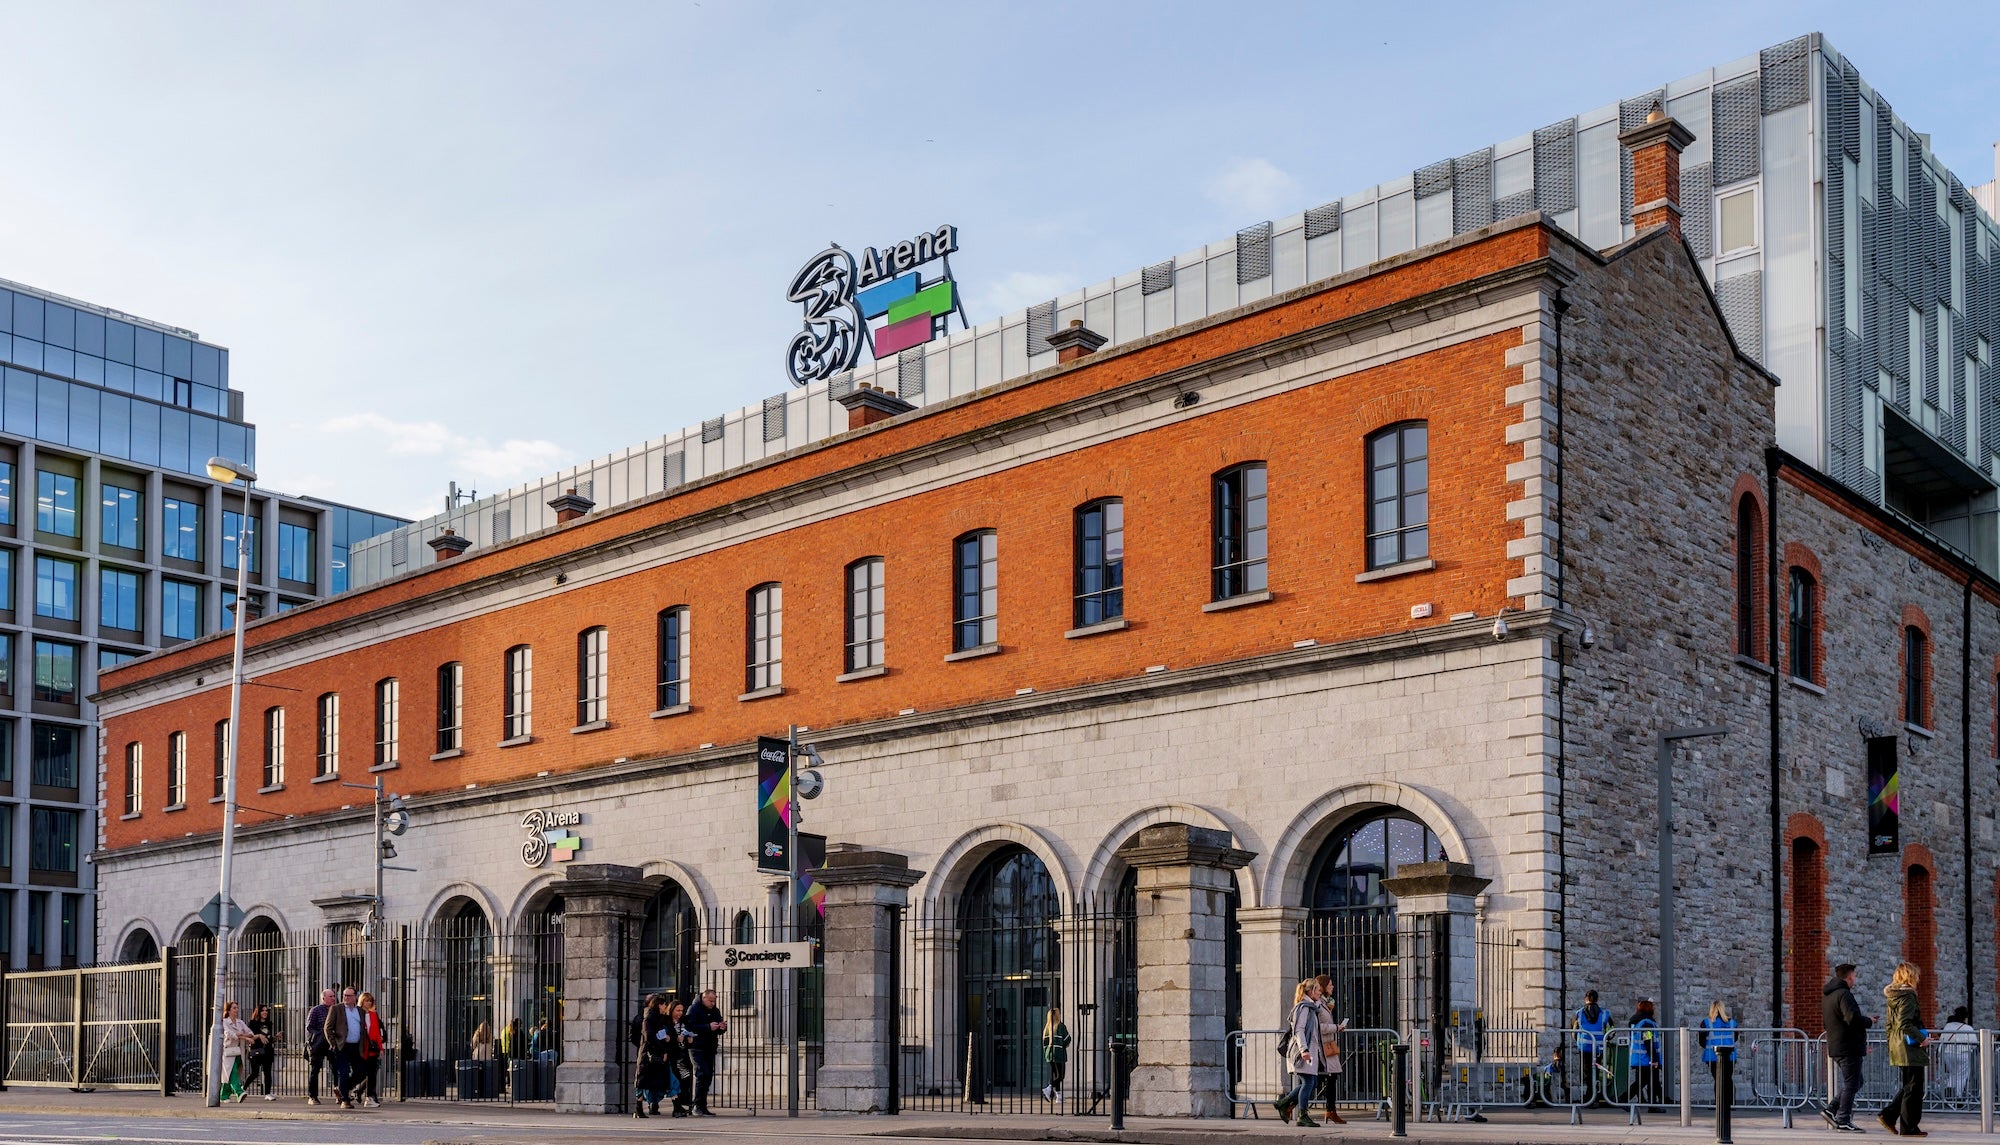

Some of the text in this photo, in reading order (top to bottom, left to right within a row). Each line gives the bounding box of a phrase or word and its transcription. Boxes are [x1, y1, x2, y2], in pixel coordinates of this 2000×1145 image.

[786, 224, 958, 389] 3 Arena
[521, 809, 581, 869] 3 Arena
[725, 948, 791, 967] 3 Concierge
